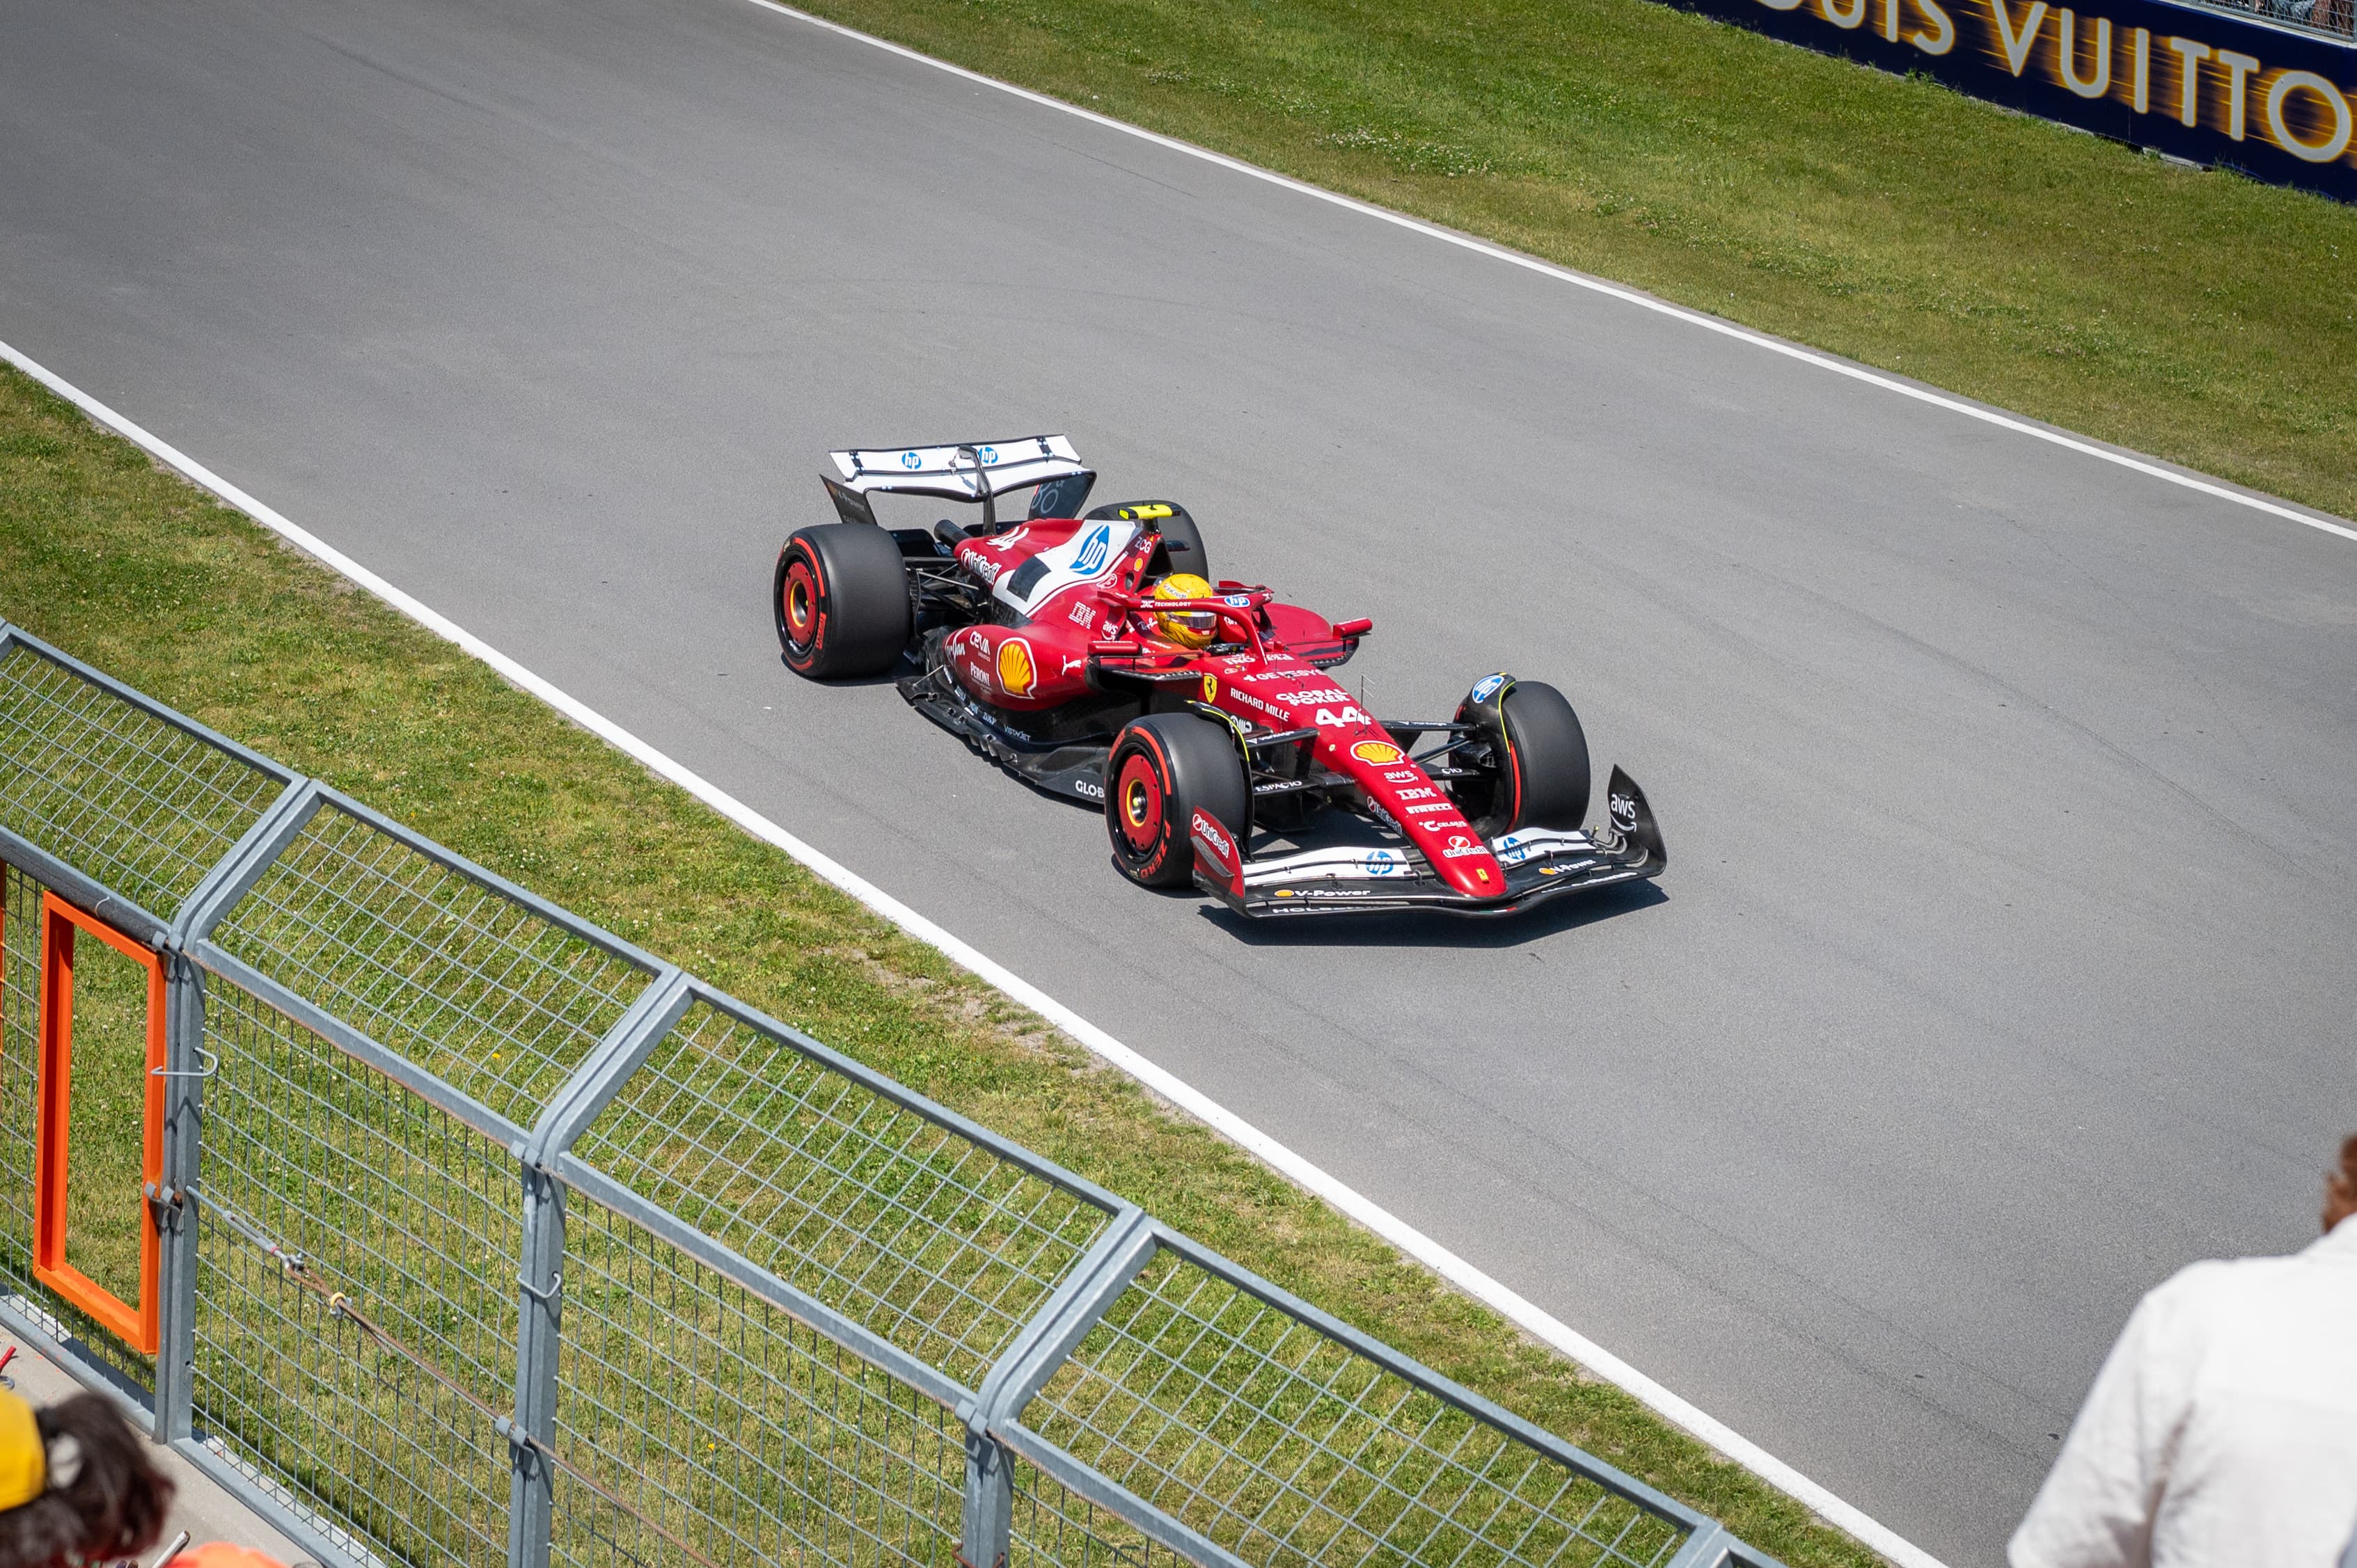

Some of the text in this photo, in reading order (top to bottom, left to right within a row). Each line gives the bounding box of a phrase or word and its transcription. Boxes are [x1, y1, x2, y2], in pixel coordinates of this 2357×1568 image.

[901, 452, 922, 470] hp
[978, 446, 998, 464] hp
[986, 525, 1030, 552] 44
[1069, 524, 1110, 576] hp
[1224, 594, 1251, 608] hp
[1068, 601, 1097, 630] IBM
[970, 660, 991, 686] PERONI
[1275, 688, 1348, 701] GLOBAL
[1288, 695, 1350, 706] POKER
[1472, 674, 1505, 704] hp
[1230, 687, 1291, 722] RICHARD MILLE
[1315, 706, 1372, 728] 44
[1254, 780, 1303, 793] ESPACIO
[1395, 787, 1437, 800] IBM
[1405, 802, 1453, 815] PIRELLI
[1610, 793, 1636, 819] aws
[1140, 819, 1172, 879] P ZERO
[1200, 819, 1230, 859] UniCredit
[1365, 850, 1394, 876] hp
[1442, 846, 1489, 858] UniCredit
